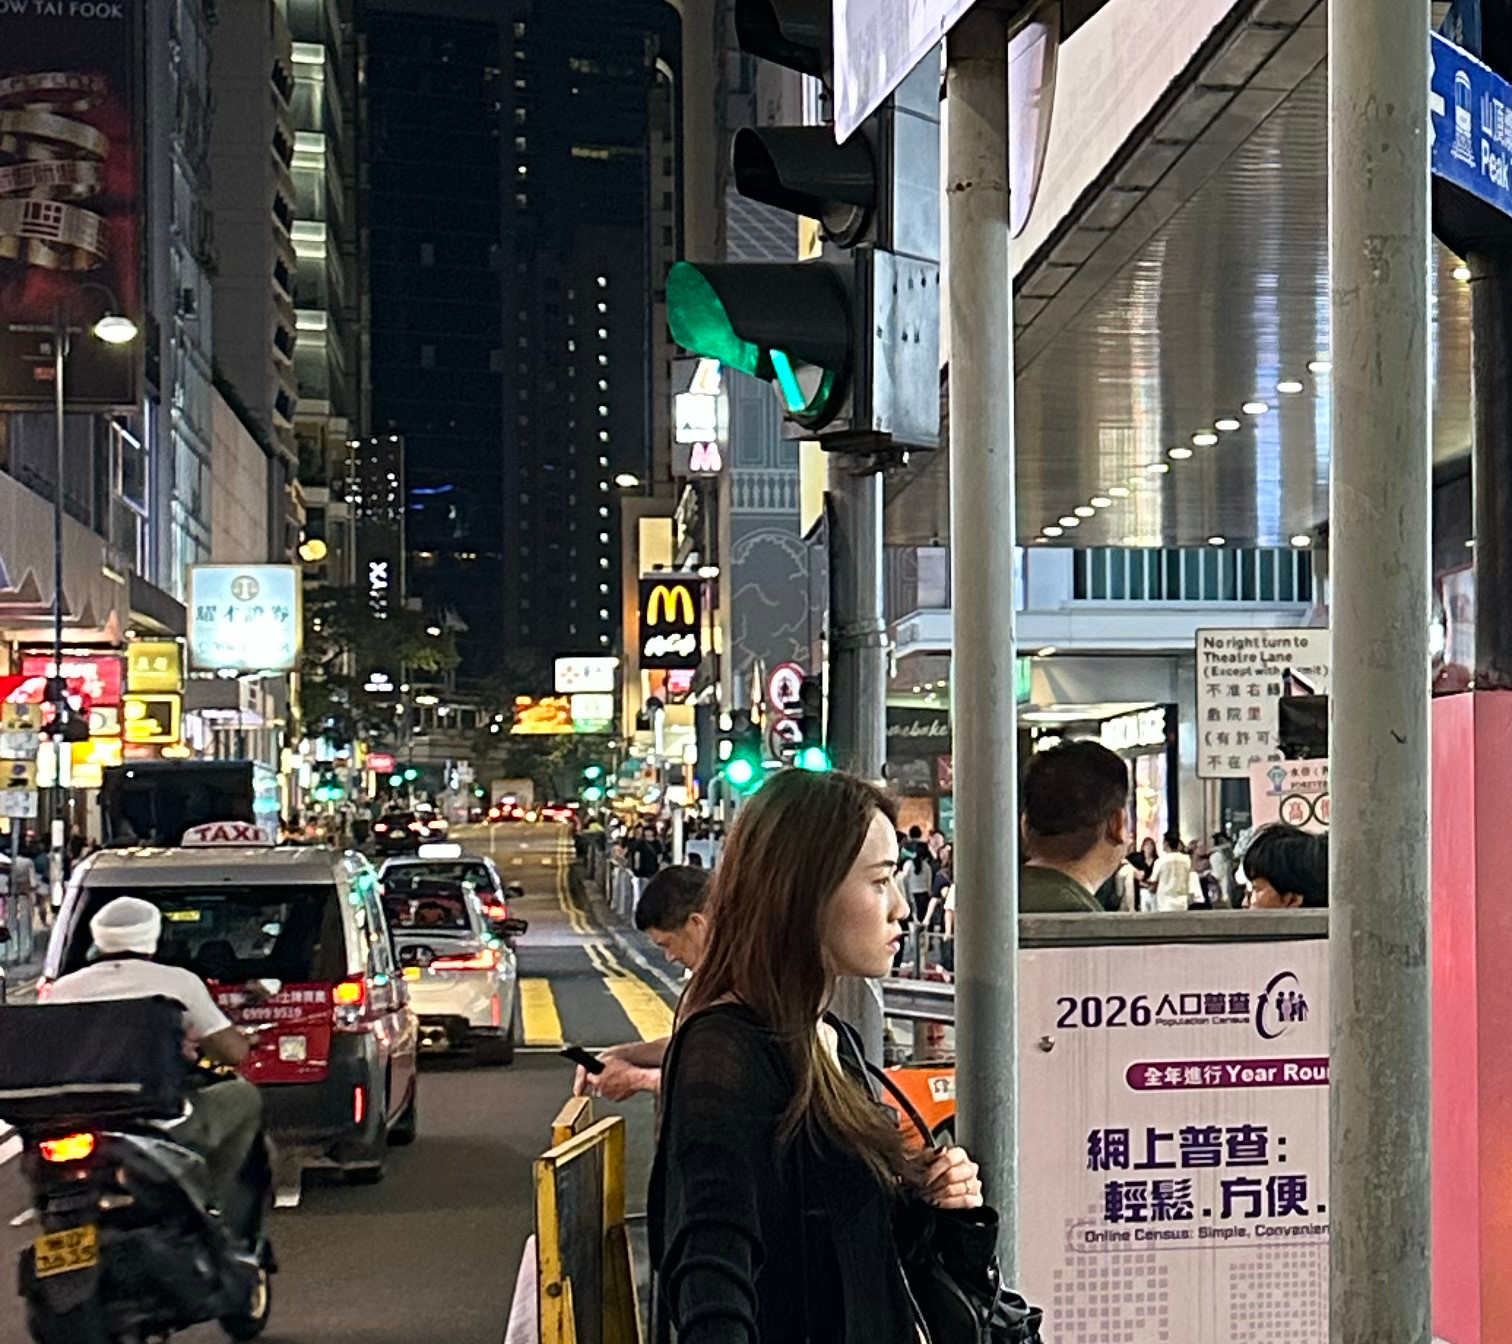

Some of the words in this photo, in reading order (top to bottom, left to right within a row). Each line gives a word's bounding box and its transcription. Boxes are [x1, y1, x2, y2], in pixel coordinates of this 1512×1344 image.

[70, 1, 123, 19] FOOK
[1481, 138, 1510, 192] Peak
[1203, 637, 1224, 649] No
[1226, 636, 1260, 651] right
[1262, 637, 1291, 648] turn
[1294, 636, 1309, 648] to
[1203, 651, 1257, 663] Theatre
[1261, 651, 1293, 663] Lane
[194, 824, 262, 842] TAXI
[1056, 995, 1151, 1028] 2026
[1155, 993, 1250, 1016] 人口普查
[1155, 1018, 1209, 1026] Population
[1144, 1065, 1222, 1087] 全年進行
[1225, 1064, 1277, 1083] Year
[1085, 1229, 1131, 1243] Online
